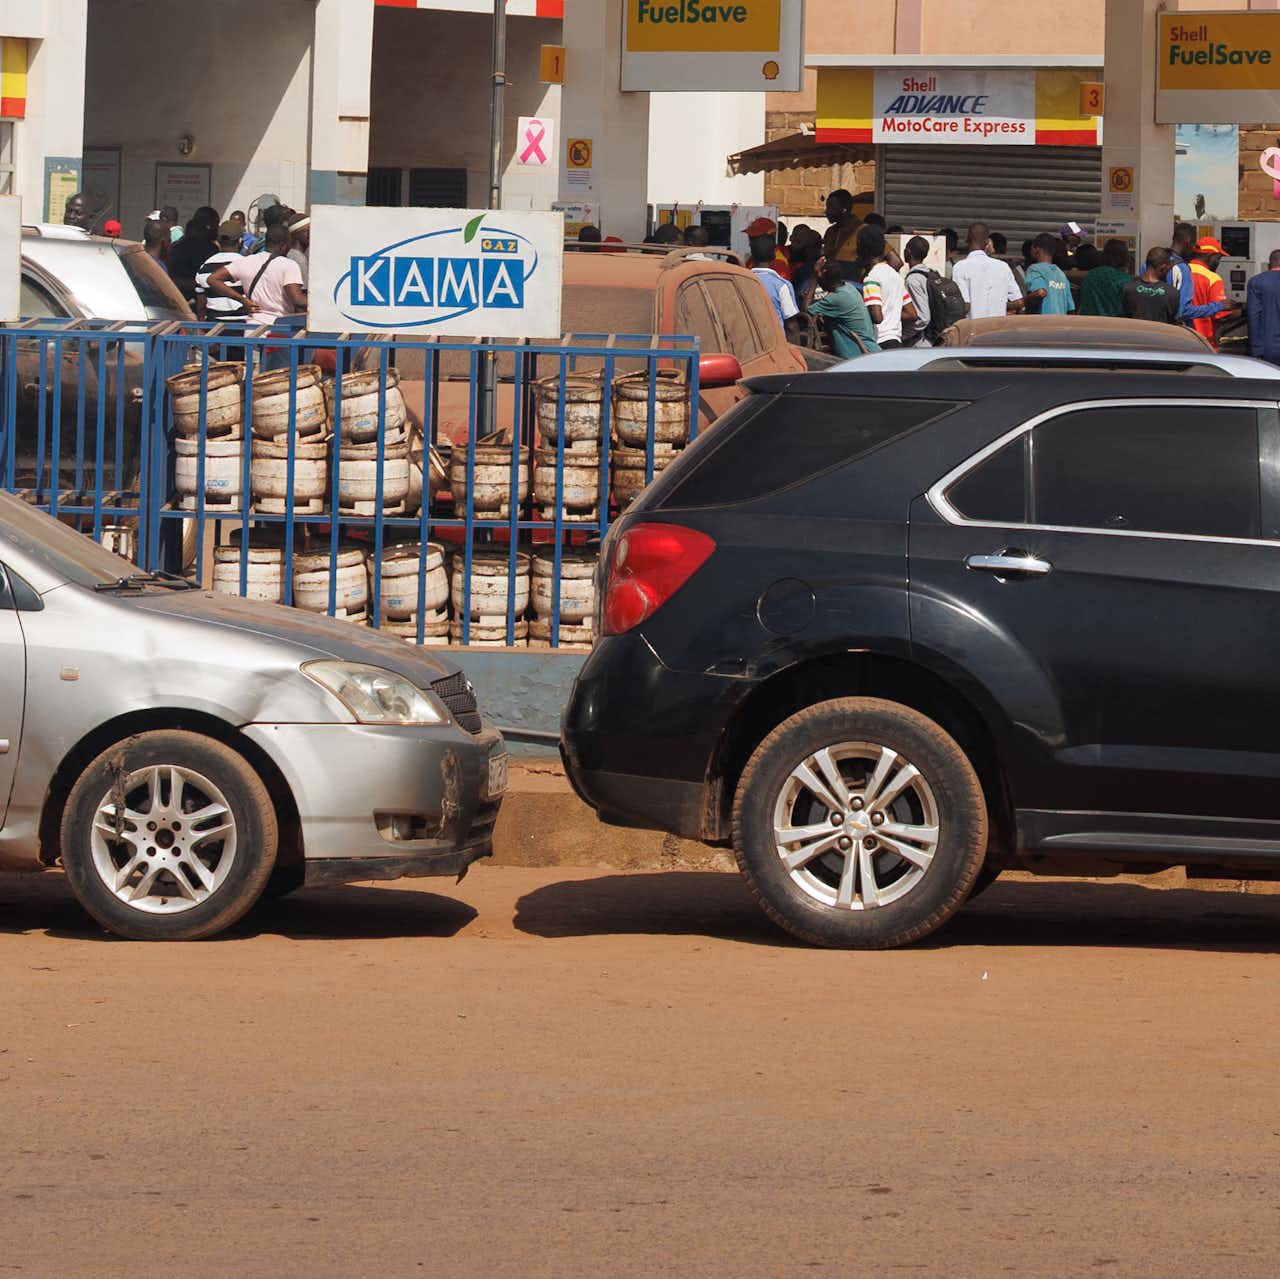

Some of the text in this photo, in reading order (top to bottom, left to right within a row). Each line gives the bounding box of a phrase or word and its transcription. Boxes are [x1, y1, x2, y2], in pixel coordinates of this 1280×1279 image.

[1170, 25, 1208, 42] Shell
[1169, 43, 1272, 65] FuelSave
[902, 77, 937, 92] Shell
[884, 95, 989, 114] ADVANCE
[1088, 89, 1100, 108] 3
[881, 117, 1026, 137] MotoCare Express
[481, 239, 518, 252] GAZ
[357, 259, 520, 305] KAMA
